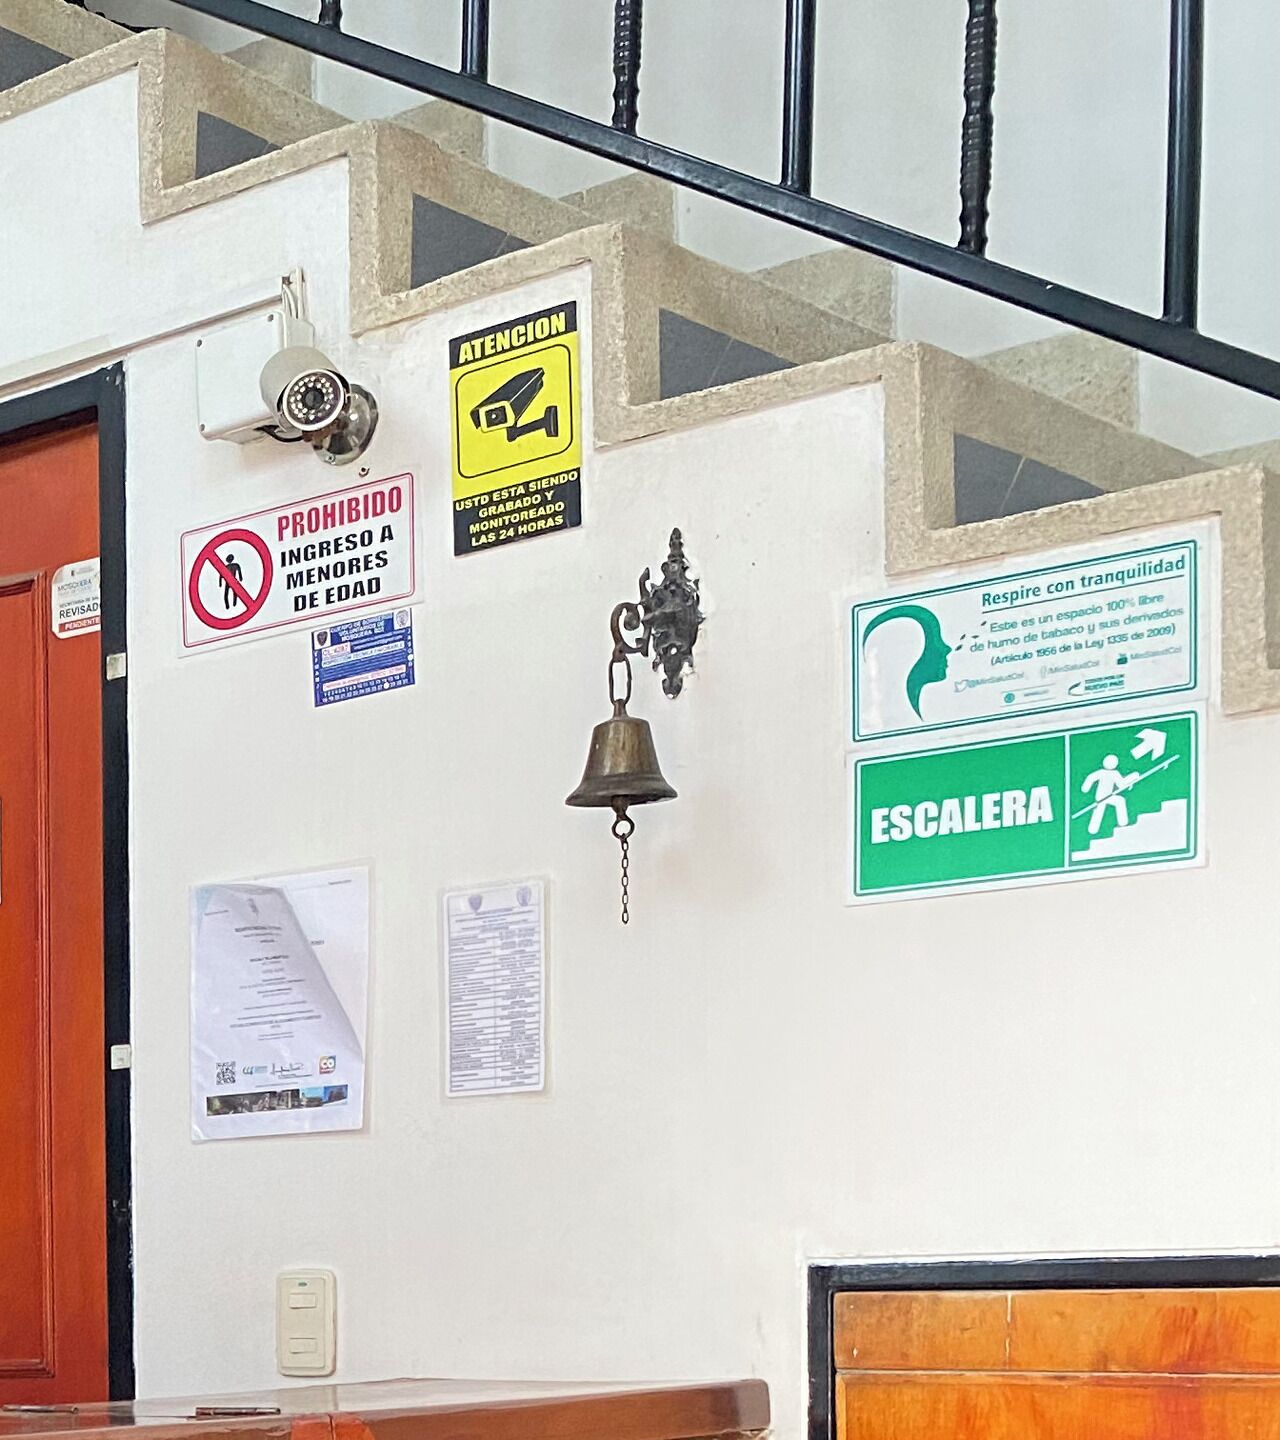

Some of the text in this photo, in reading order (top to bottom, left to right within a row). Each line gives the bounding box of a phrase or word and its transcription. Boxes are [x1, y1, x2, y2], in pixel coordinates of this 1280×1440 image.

[458, 311, 566, 364] ATENCION
[455, 471, 578, 512] USTD ESTA SIENDO
[478, 490, 555, 518] GRABADO Y
[278, 486, 402, 542] PROHIBIDO
[468, 501, 565, 534] MONITOREADO
[471, 516, 564, 547] LAS 24 HORAS
[280, 524, 394, 568] INGRESO A
[286, 550, 389, 590] MENORES
[982, 554, 1185, 607] Respire con tranquilidad
[60, 602, 100, 619] REVISAD
[293, 577, 381, 612] DE EDAD
[990, 594, 1164, 633] Este es un espacio 100% libre
[970, 607, 1184, 653] de humo de tabaco y sus derivados
[1059, 644, 1071, 652] de
[1074, 641, 1082, 650] la
[1085, 639, 1104, 649] Ley
[1107, 633, 1128, 645] 1335
[1130, 632, 1144, 641] de
[1146, 623, 1176, 638] 2009)
[870, 785, 1055, 845] ESCALERA
